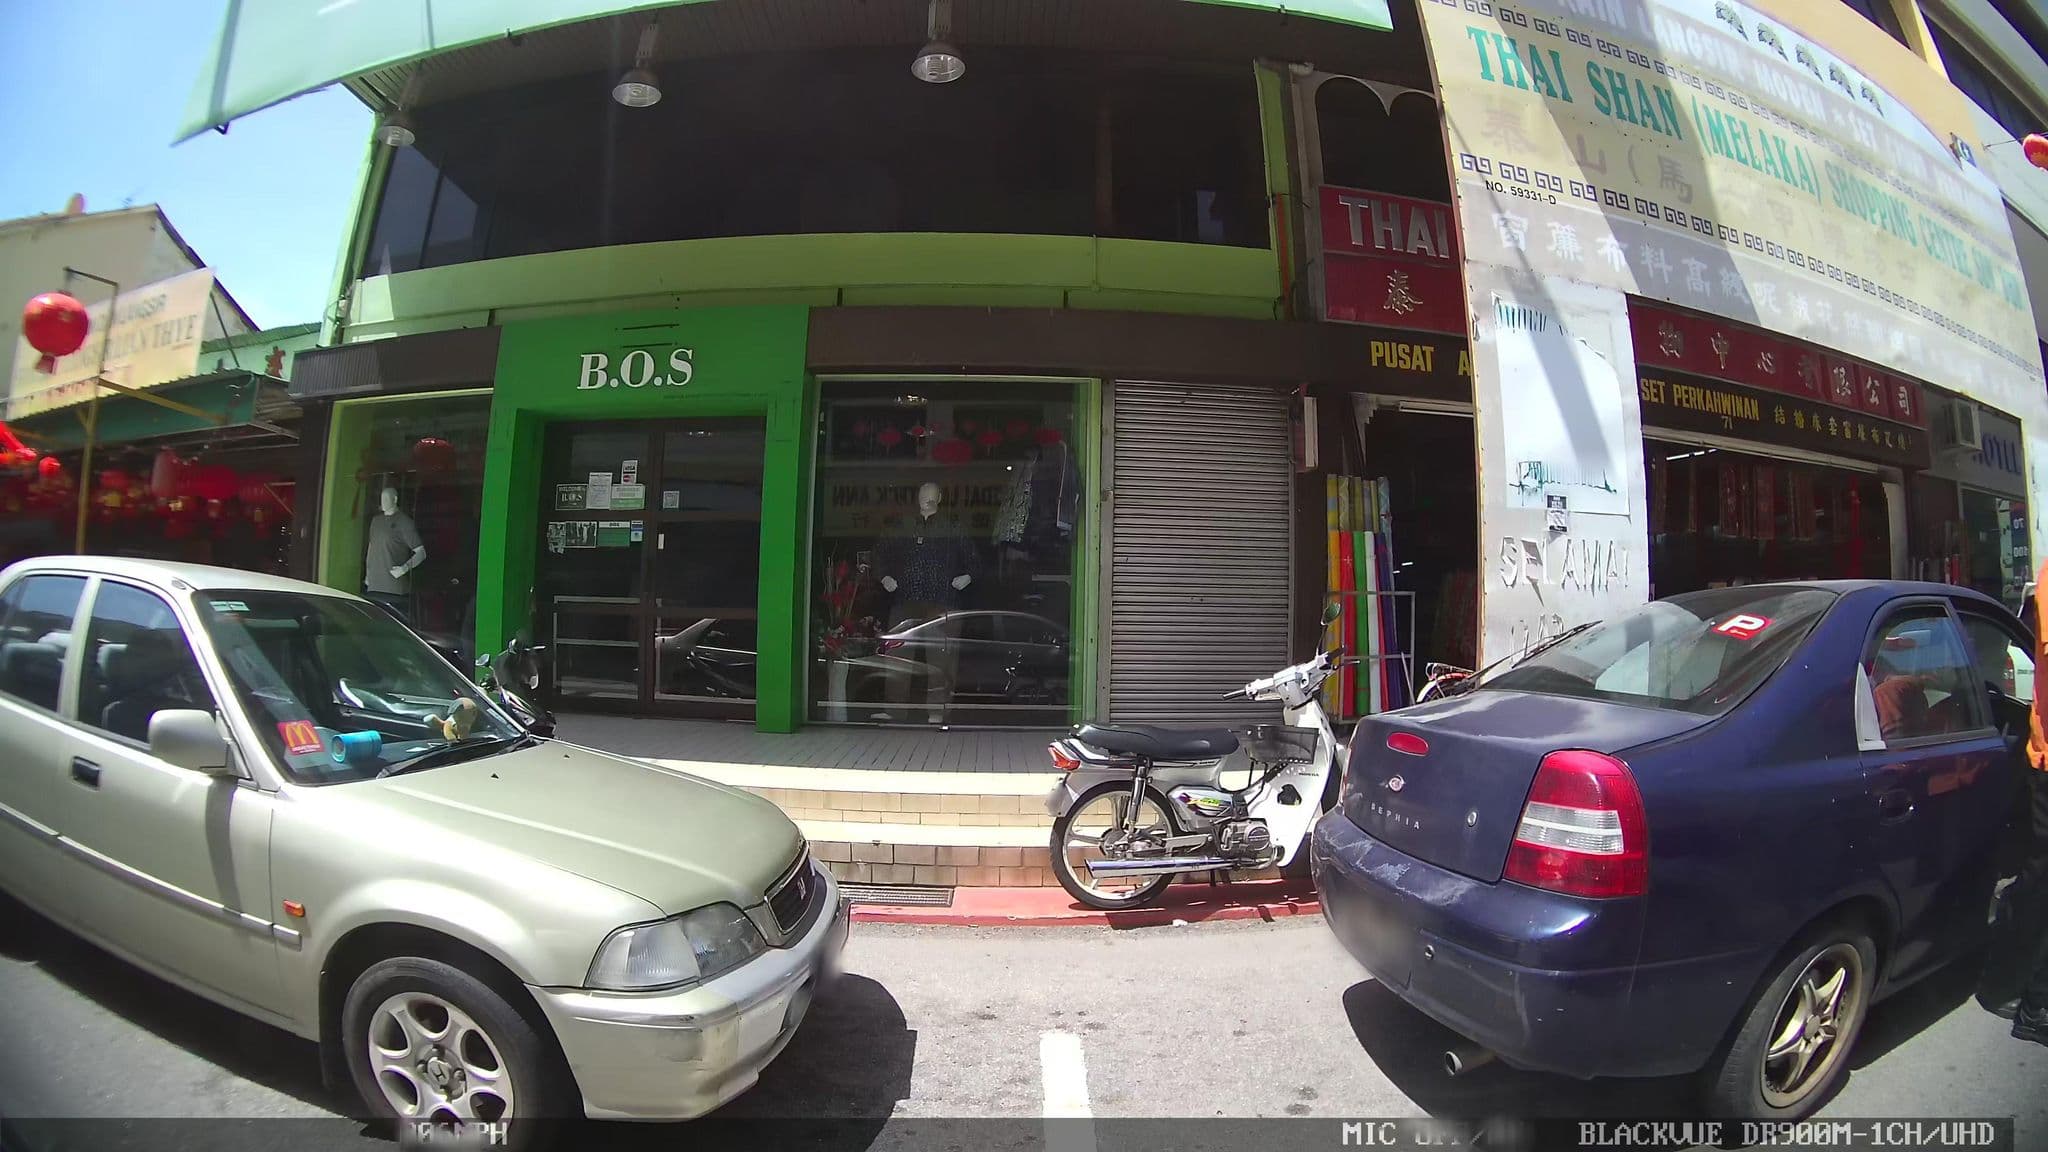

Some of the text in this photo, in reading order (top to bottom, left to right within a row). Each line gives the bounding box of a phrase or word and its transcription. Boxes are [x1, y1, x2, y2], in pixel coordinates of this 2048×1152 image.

[1466, 25, 1574, 103] THAI
[1586, 60, 1683, 140] SHAN
[1692, 95, 1822, 205] (MELAKA)
[1485, 179, 1557, 206] NO. 59331-D
[1338, 193, 1450, 260] THAI
[576, 348, 695, 391] B.O.S
[1370, 340, 1435, 373] PUSAT
[1641, 378, 1760, 421] SET PERKAHWINAN
[1721, 415, 1734, 430] 71
[1717, 614, 1765, 632] P
